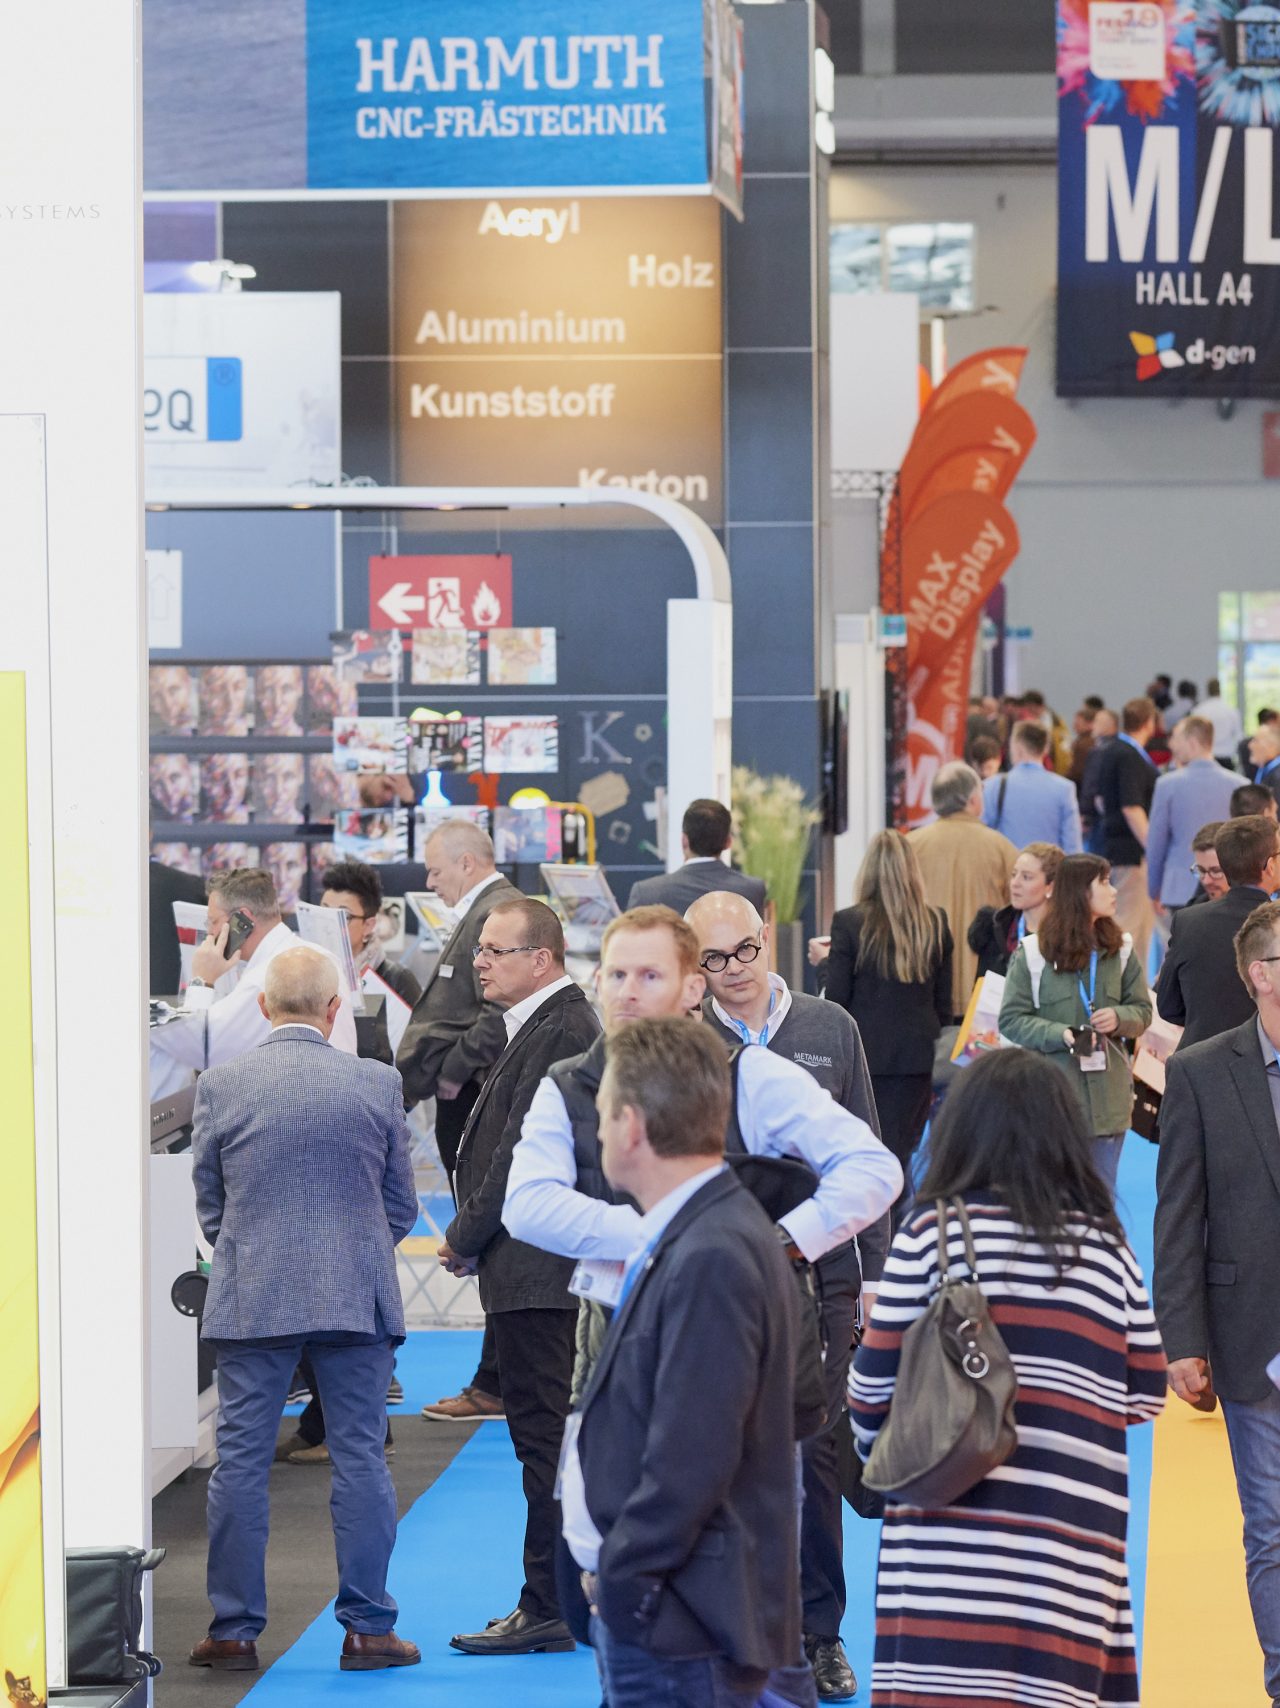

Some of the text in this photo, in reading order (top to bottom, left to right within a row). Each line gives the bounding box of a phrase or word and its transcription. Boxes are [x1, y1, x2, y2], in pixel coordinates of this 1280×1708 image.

[356, 34, 664, 92] HARMUTH
[356, 99, 667, 138] CNC-FRÄSTECHNIK
[0, 203, 101, 219] YSTEMS
[478, 201, 580, 244] Acryl
[628, 255, 714, 289] Holz
[1135, 271, 1254, 306] HALL A4
[416, 311, 626, 345] Aluminium
[410, 383, 616, 418] Kunststoff
[907, 550, 957, 633] MAX
[929, 518, 1006, 640] Display
[793, 1052, 832, 1064] METAMARK
